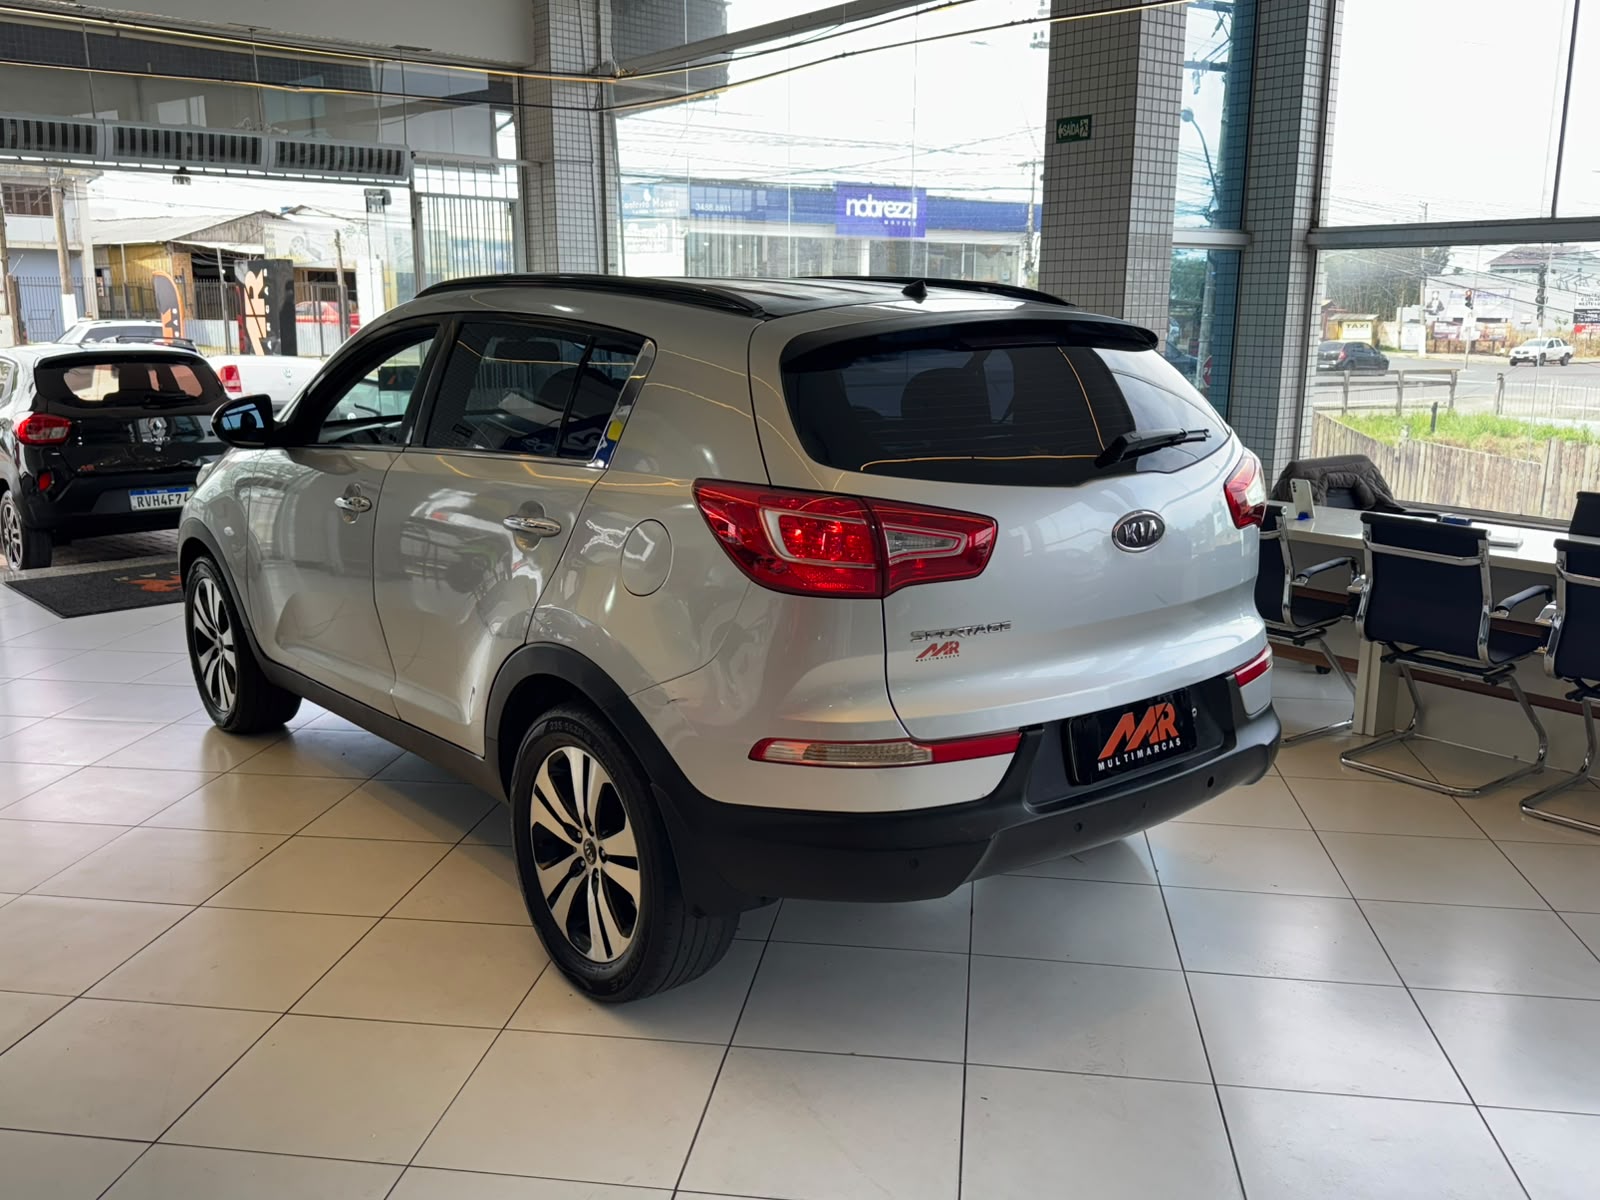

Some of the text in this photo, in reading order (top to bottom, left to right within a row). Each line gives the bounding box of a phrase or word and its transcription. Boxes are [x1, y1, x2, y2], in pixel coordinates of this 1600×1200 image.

[845, 193, 918, 219] nobrezzi
[1123, 519, 1159, 545] KIA
[909, 620, 1012, 643] SPORTAGE
[1097, 737, 1182, 772] MULTIMARCAS
